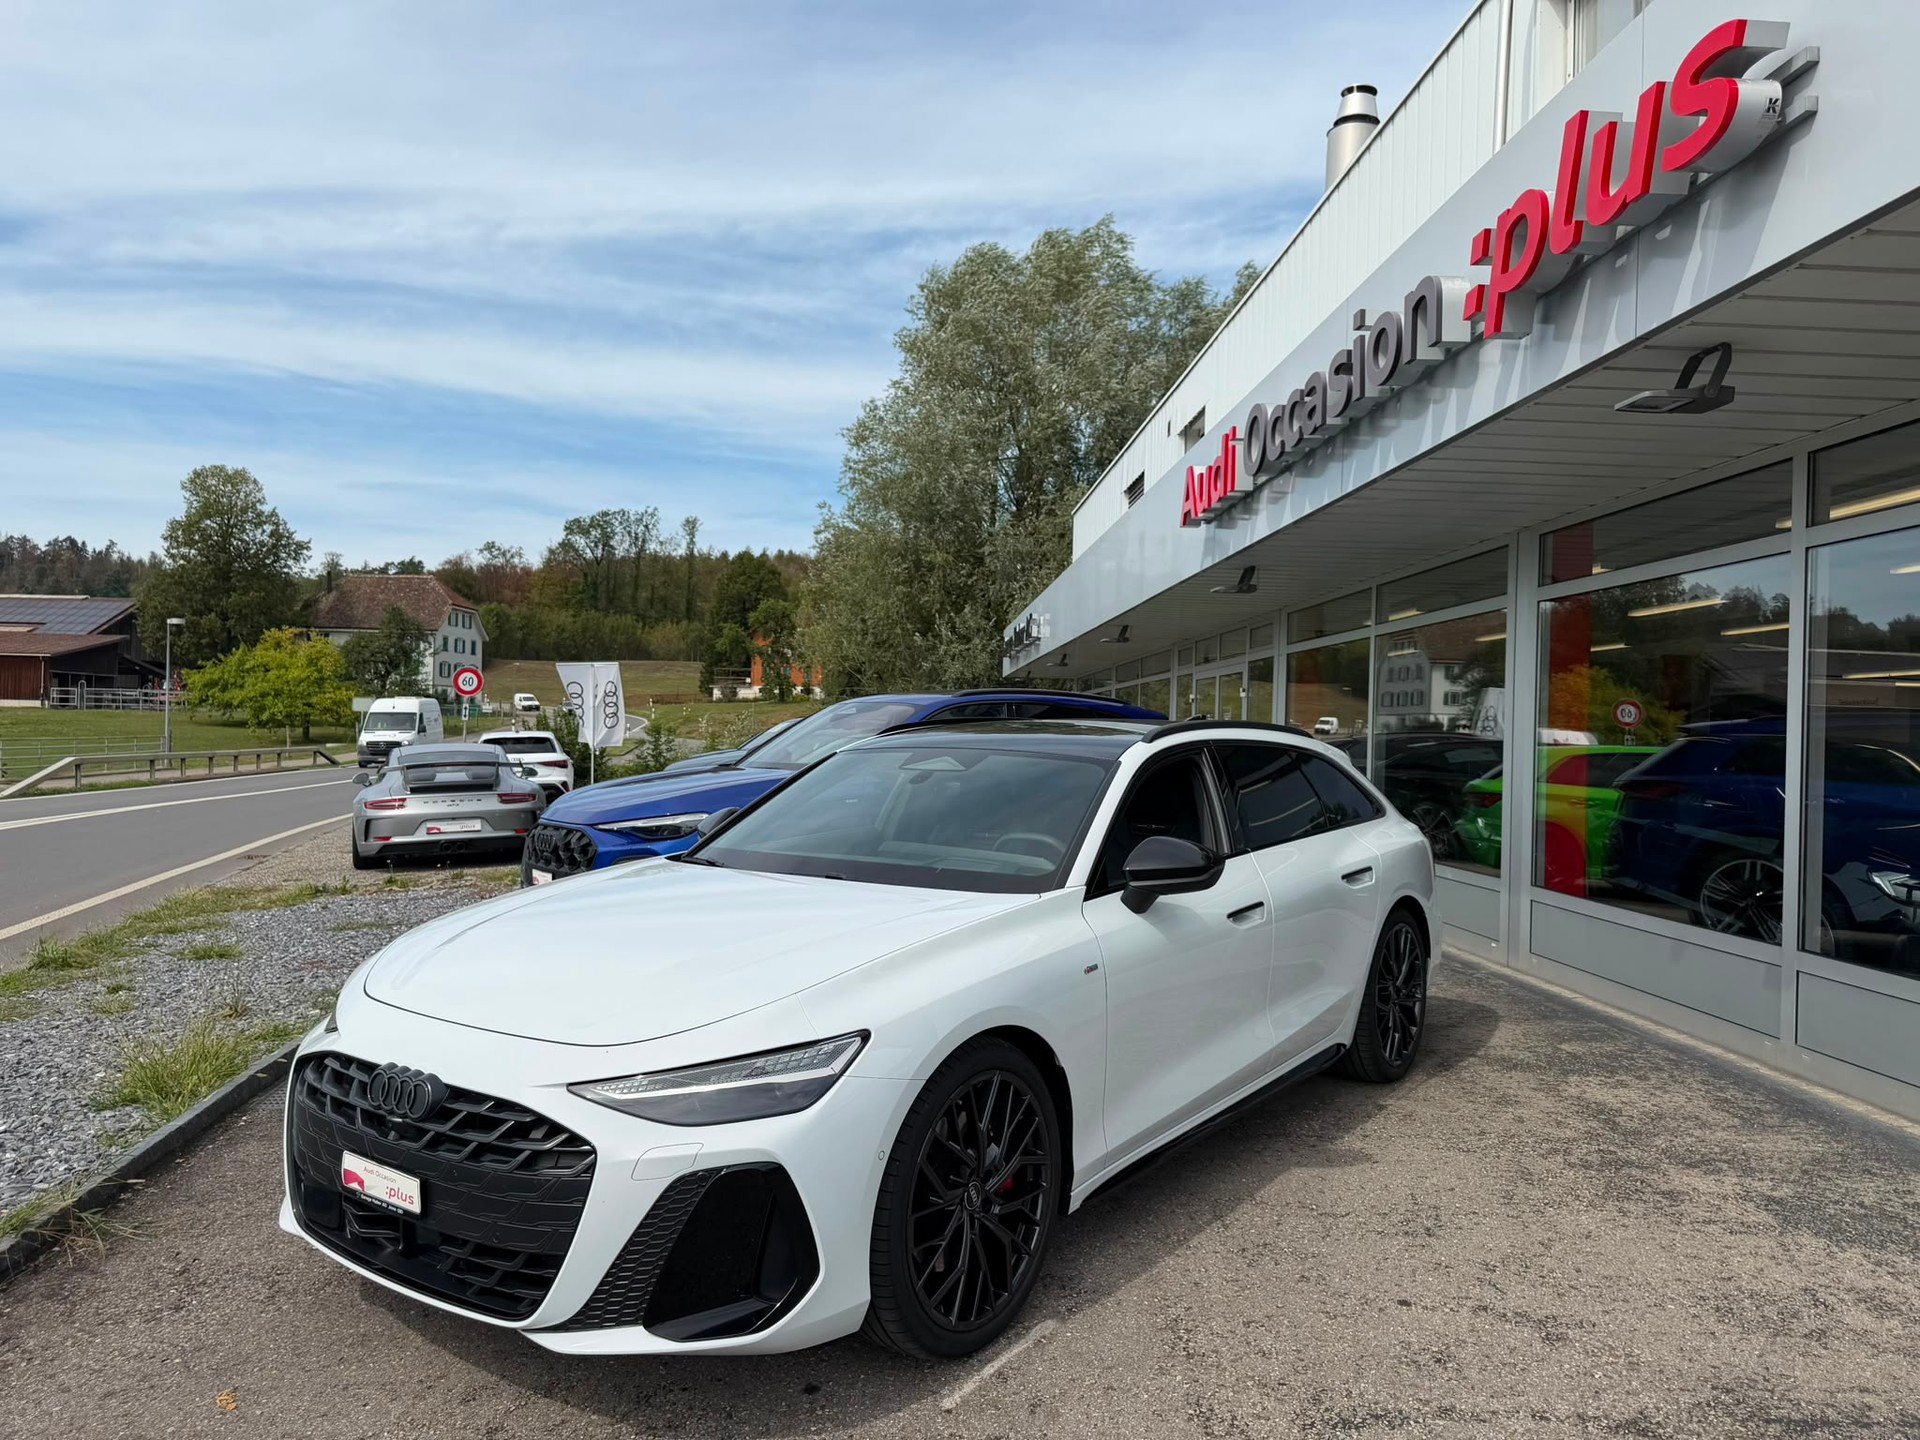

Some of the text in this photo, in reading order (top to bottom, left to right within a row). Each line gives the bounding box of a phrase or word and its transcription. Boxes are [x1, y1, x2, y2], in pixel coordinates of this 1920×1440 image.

[1180, 18, 1748, 528] Audi Occasion :plus
[462, 676, 474, 687] 60
[363, 1166, 397, 1184] Audi Occasion
[385, 1185, 415, 1205] :plus
